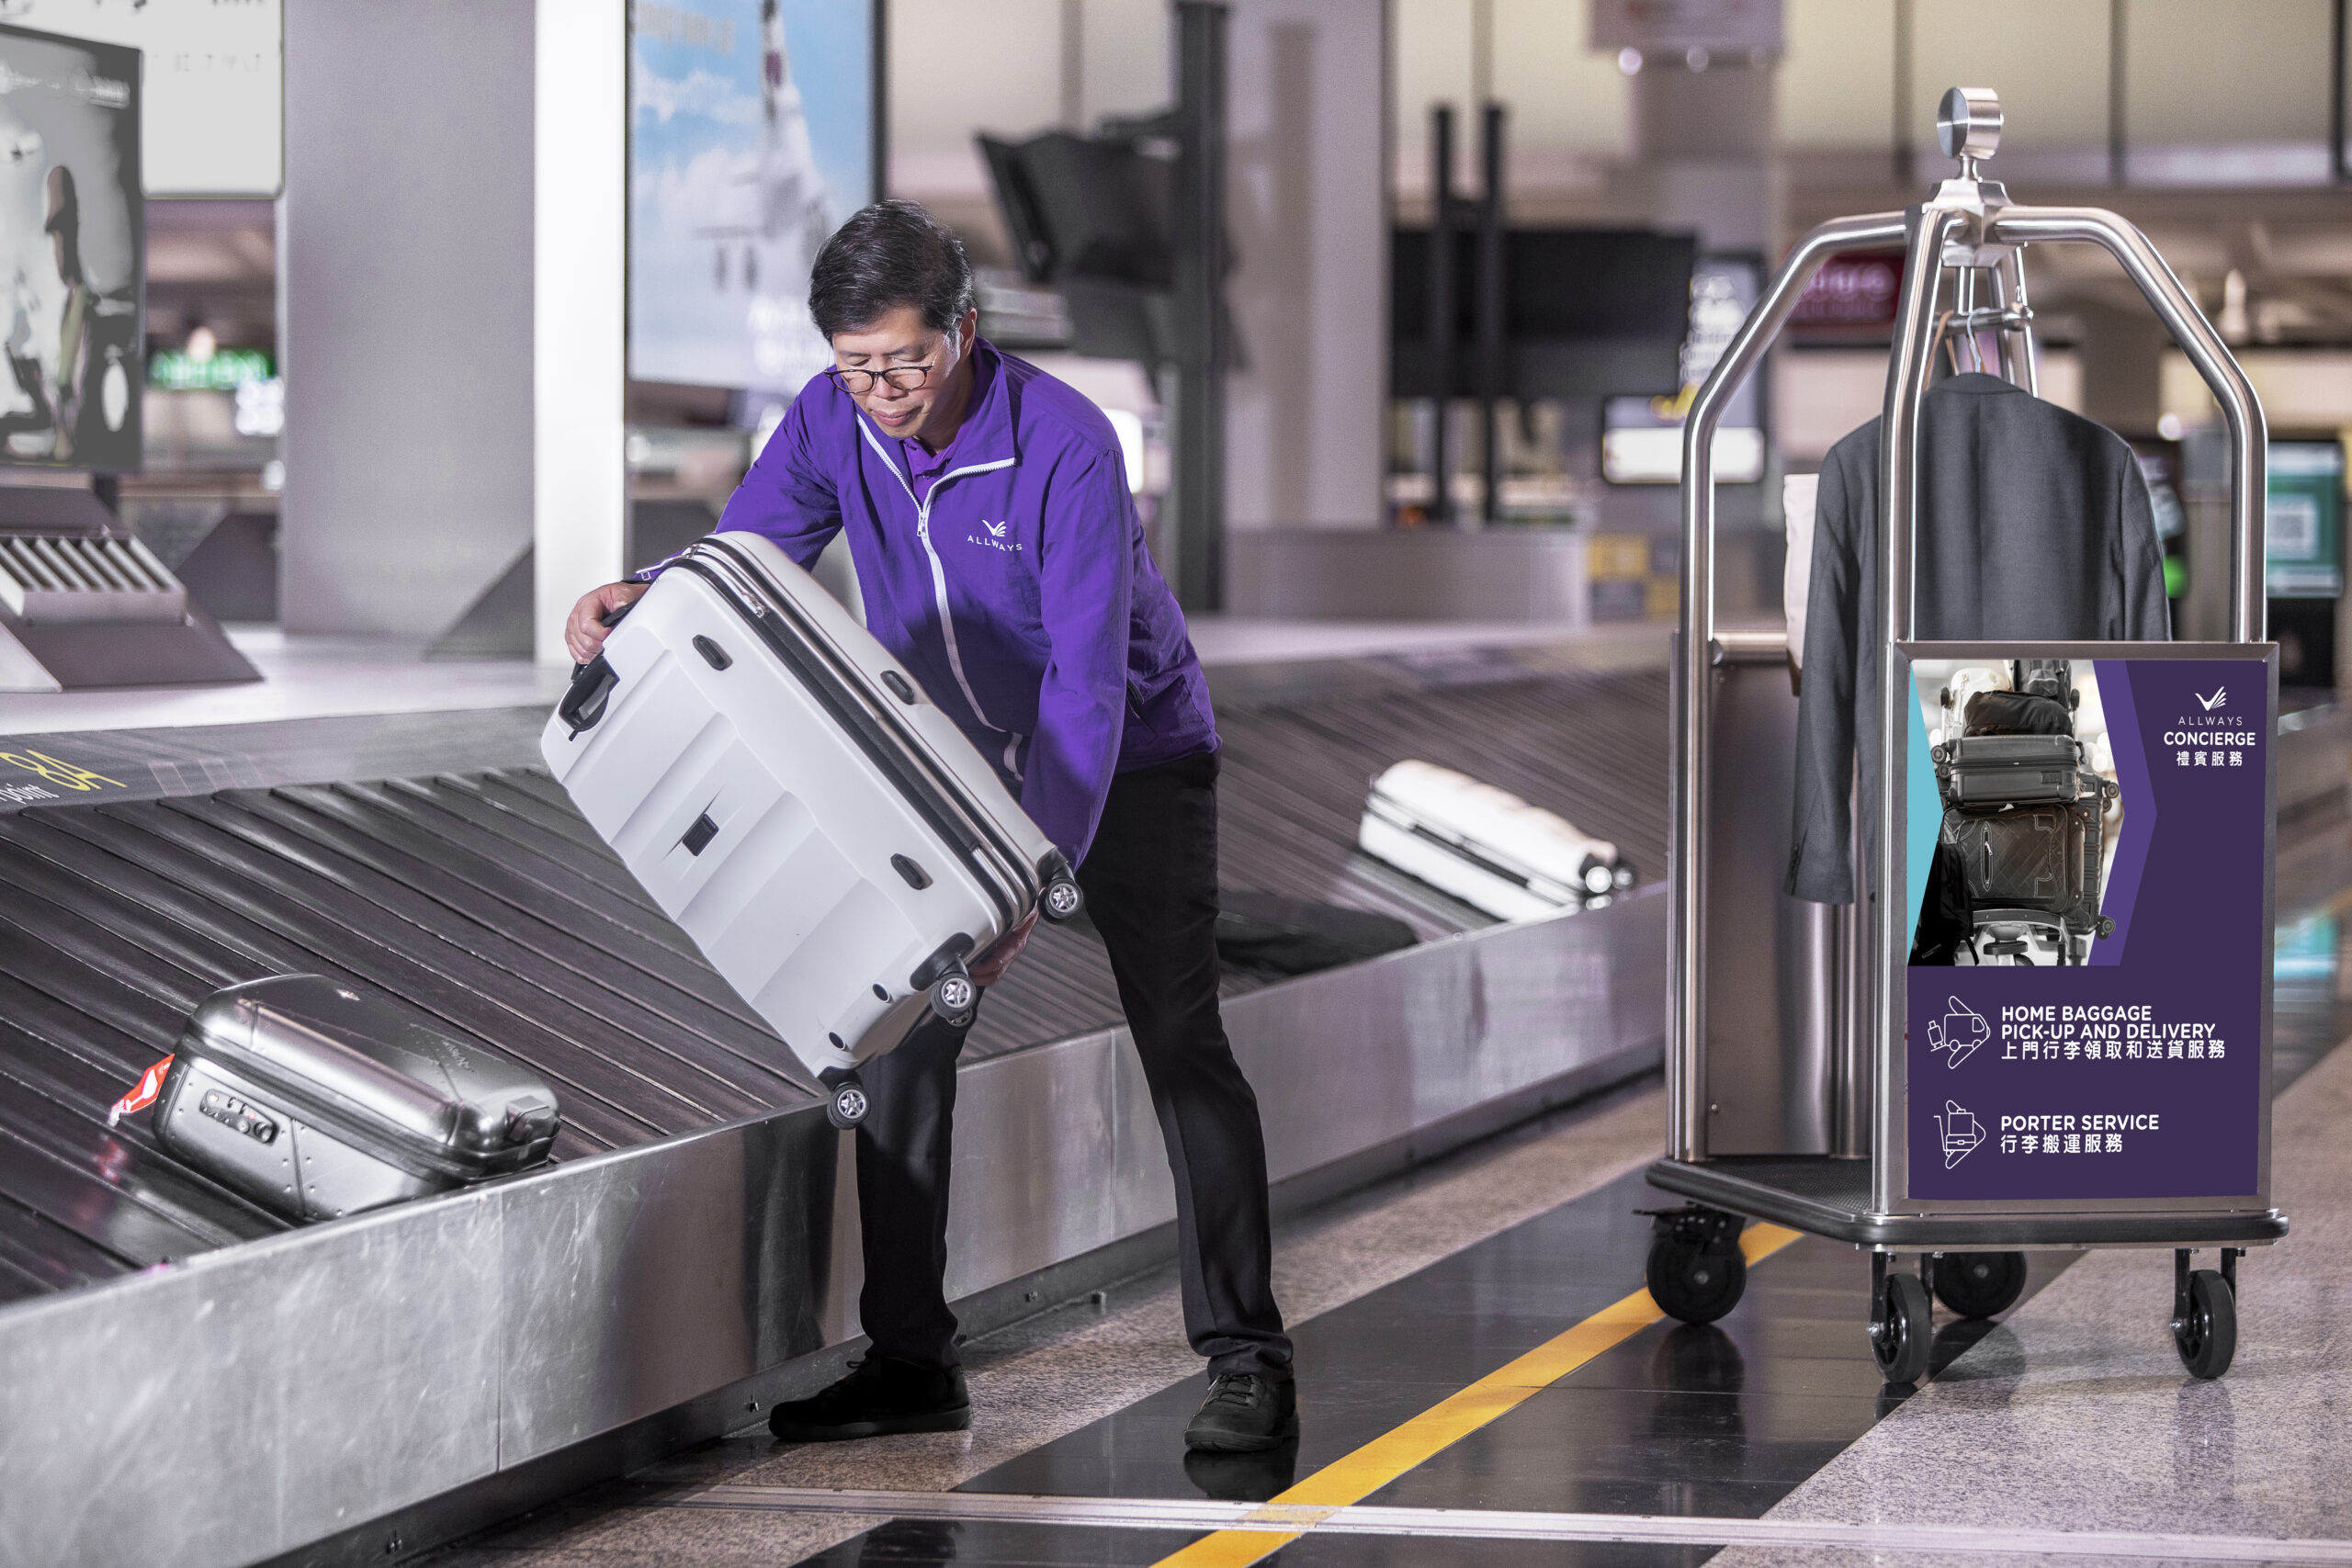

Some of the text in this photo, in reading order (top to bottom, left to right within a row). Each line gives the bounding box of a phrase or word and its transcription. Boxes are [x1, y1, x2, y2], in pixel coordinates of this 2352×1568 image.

[967, 535, 1023, 552] ALLWAYS
[2177, 716, 2243, 727] ALLWAYS
[2163, 731, 2256, 746] CONCIERGE
[2176, 750, 2243, 767] 禮賓服務
[0, 749, 128, 792] 8A
[0, 783, 60, 806] point
[2001, 1005, 2153, 1022] HOME BAGGAGE
[2001, 1023, 2216, 1040] PICK-UP AND DELIVERY
[2000, 1039, 2226, 1060] 上門行李領取和送貨服務
[2000, 1114, 2160, 1132] PORTER SERVICE
[2000, 1134, 2123, 1155] 行李搬運服務
